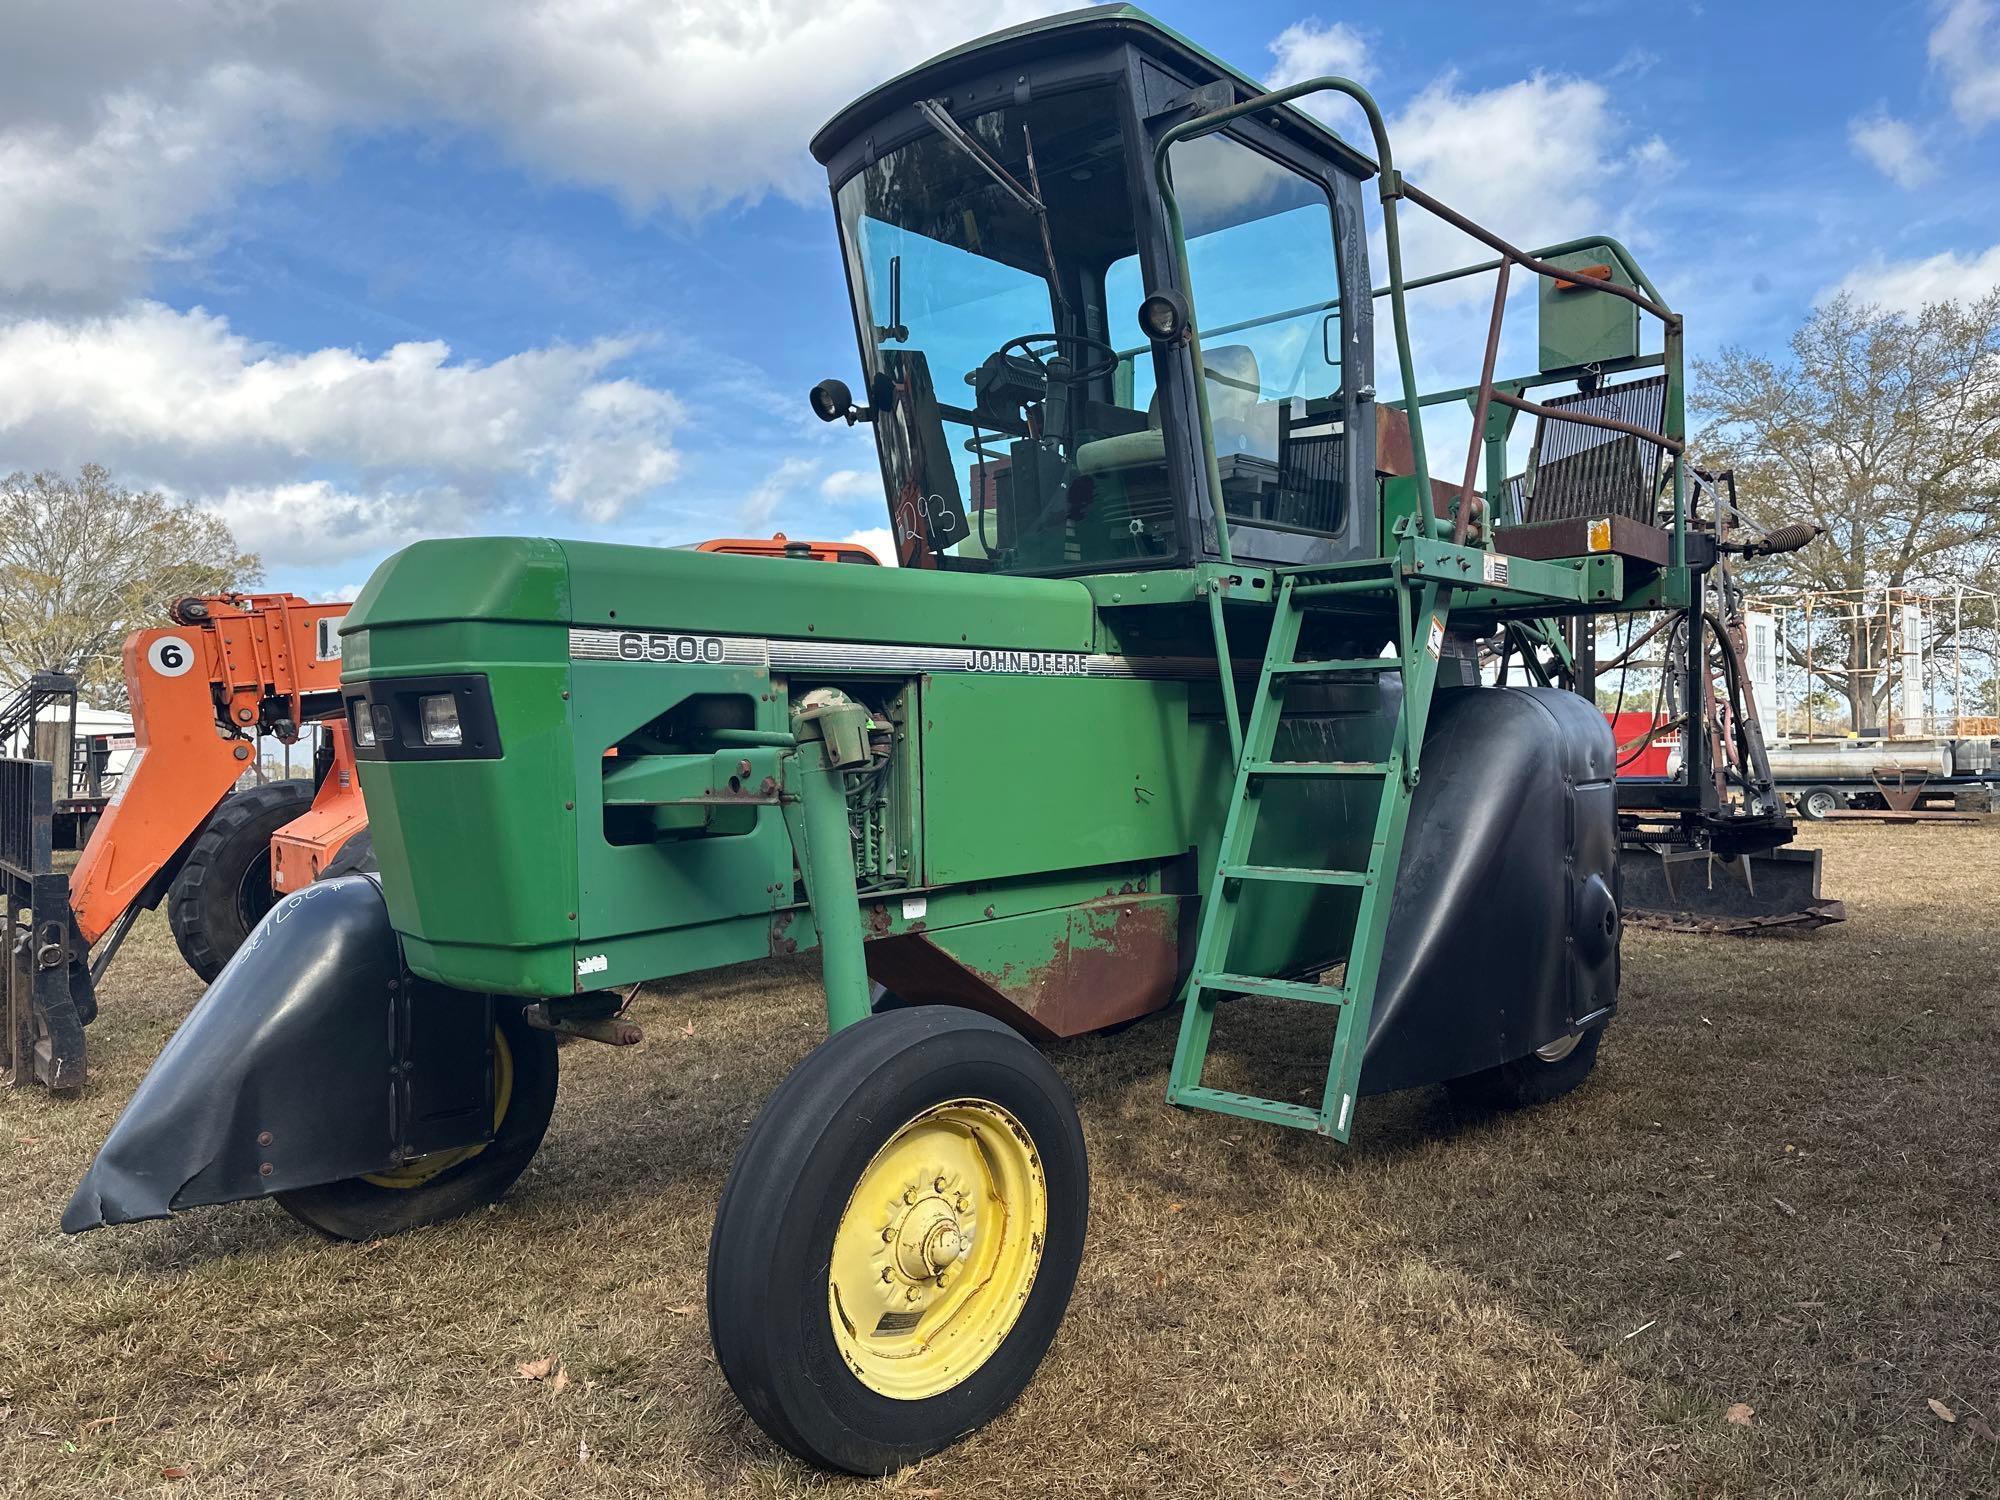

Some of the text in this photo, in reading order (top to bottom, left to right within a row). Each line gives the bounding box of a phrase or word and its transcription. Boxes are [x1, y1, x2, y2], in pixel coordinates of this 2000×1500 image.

[160, 644, 184, 669] 6
[619, 632, 724, 663] 6500
[966, 650, 1088, 673] JOHN DEERE
